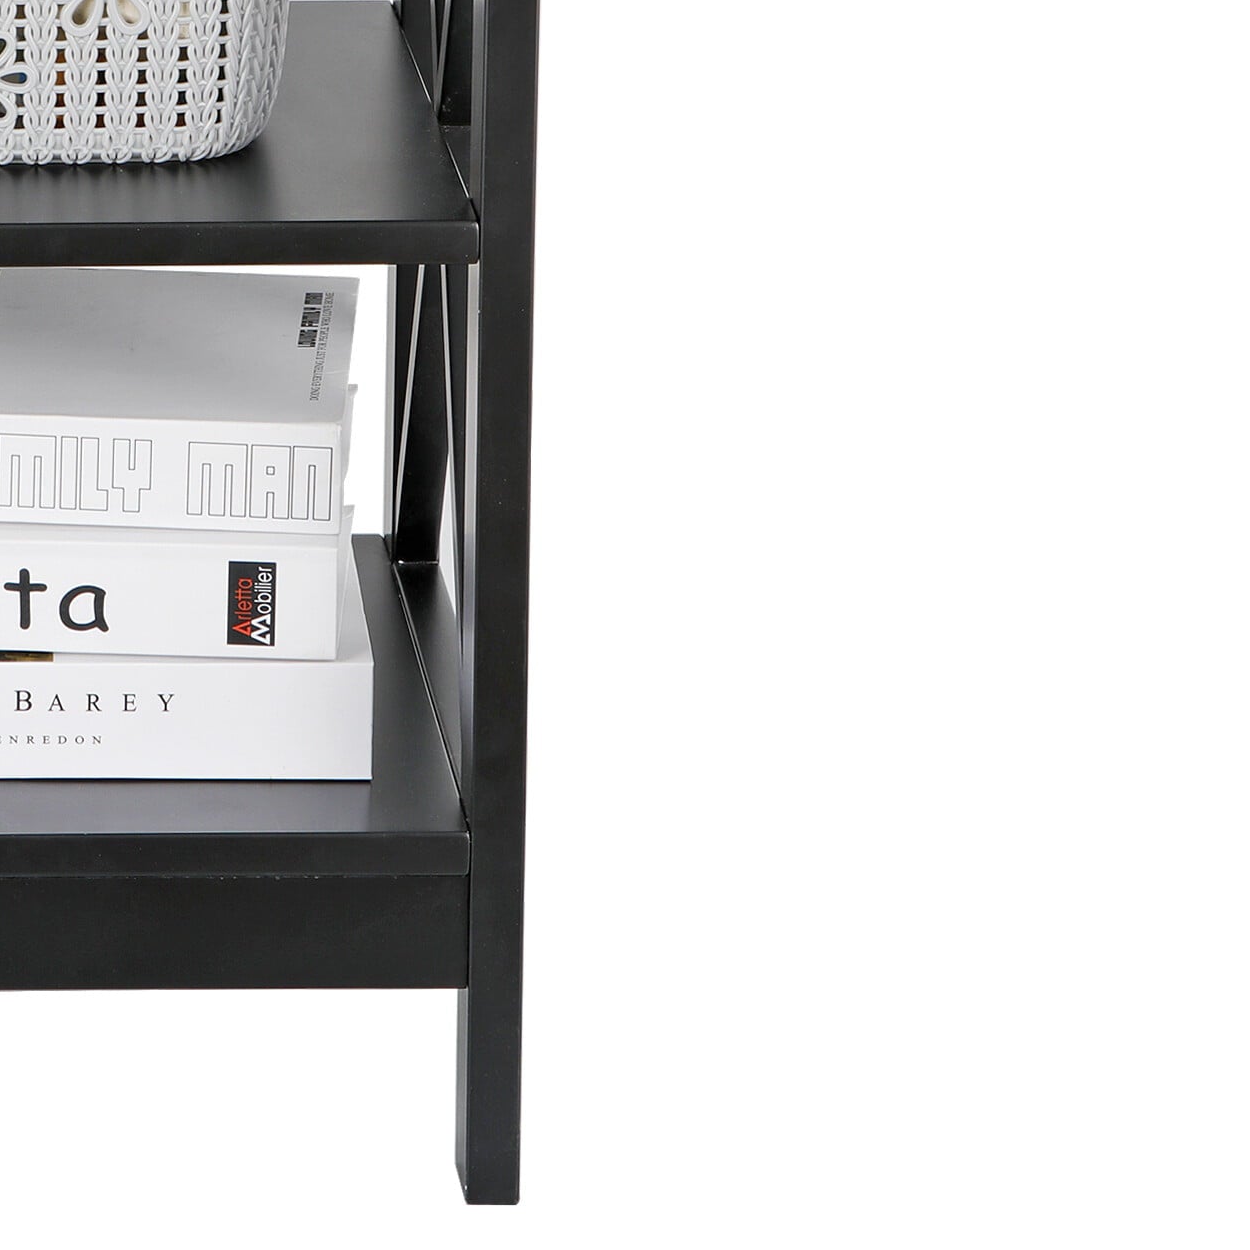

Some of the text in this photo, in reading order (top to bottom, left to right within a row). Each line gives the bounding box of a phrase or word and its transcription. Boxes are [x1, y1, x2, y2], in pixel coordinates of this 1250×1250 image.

[301, 307, 321, 327] FAMILY
[186, 441, 333, 521] MAN
[232, 577, 253, 637] Arletta
[250, 566, 273, 646] Mobilier
[14, 689, 176, 712] BAREY
